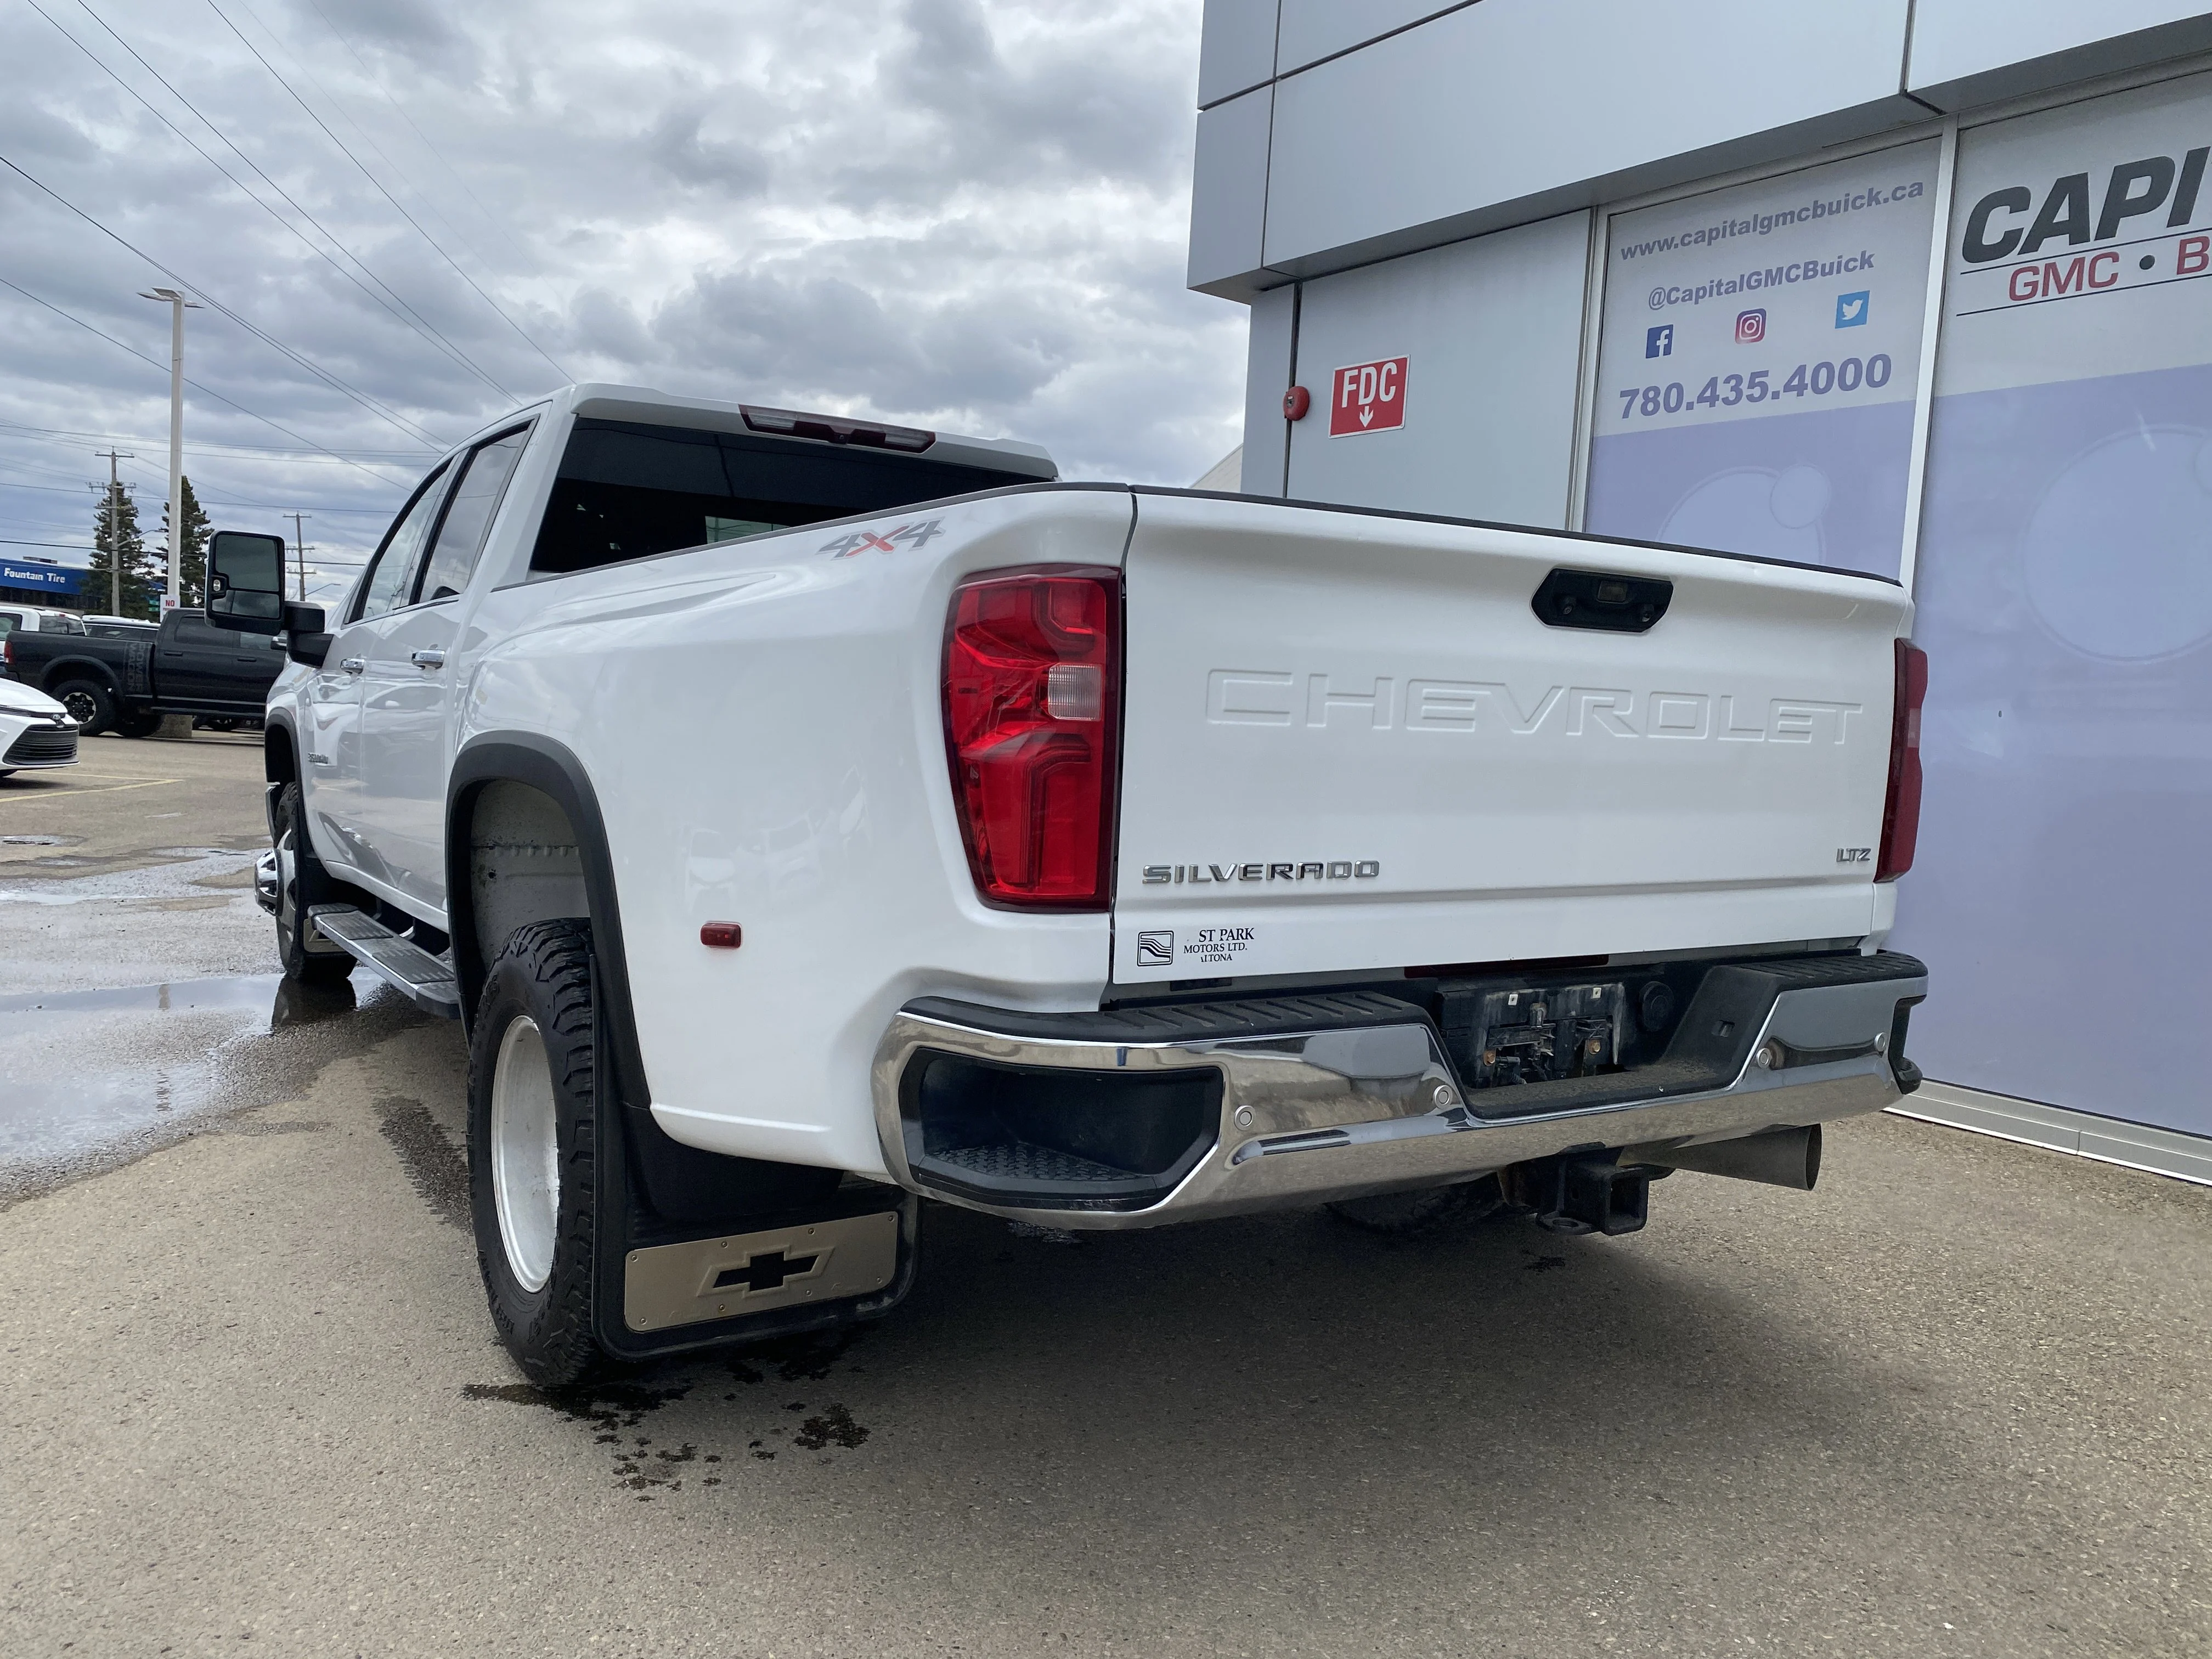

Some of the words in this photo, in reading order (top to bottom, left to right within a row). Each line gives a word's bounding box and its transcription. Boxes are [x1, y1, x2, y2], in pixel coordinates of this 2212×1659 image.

[1621, 181, 1923, 260] www.capitalgmcbuick.ca
[1962, 146, 2212, 263] CAPI
[1648, 250, 1875, 311] @CapitalGMCBuick
[2009, 251, 2120, 301] GMC
[2176, 236, 2210, 275] B
[1342, 362, 1397, 408] FDC
[1619, 353, 1892, 419] 780.435.4000
[4, 567, 43, 581] Fountain
[47, 572, 65, 583] Tire
[1206, 668, 1863, 745] CHEVROLET
[1142, 860, 1380, 884] SILVERADO
[1836, 848, 1871, 862] LTZ
[1183, 943, 1224, 953] MOTORS
[1228, 943, 1248, 951] LTD.
[1199, 929, 1216, 943] ST
[1219, 928, 1254, 941] PARK
